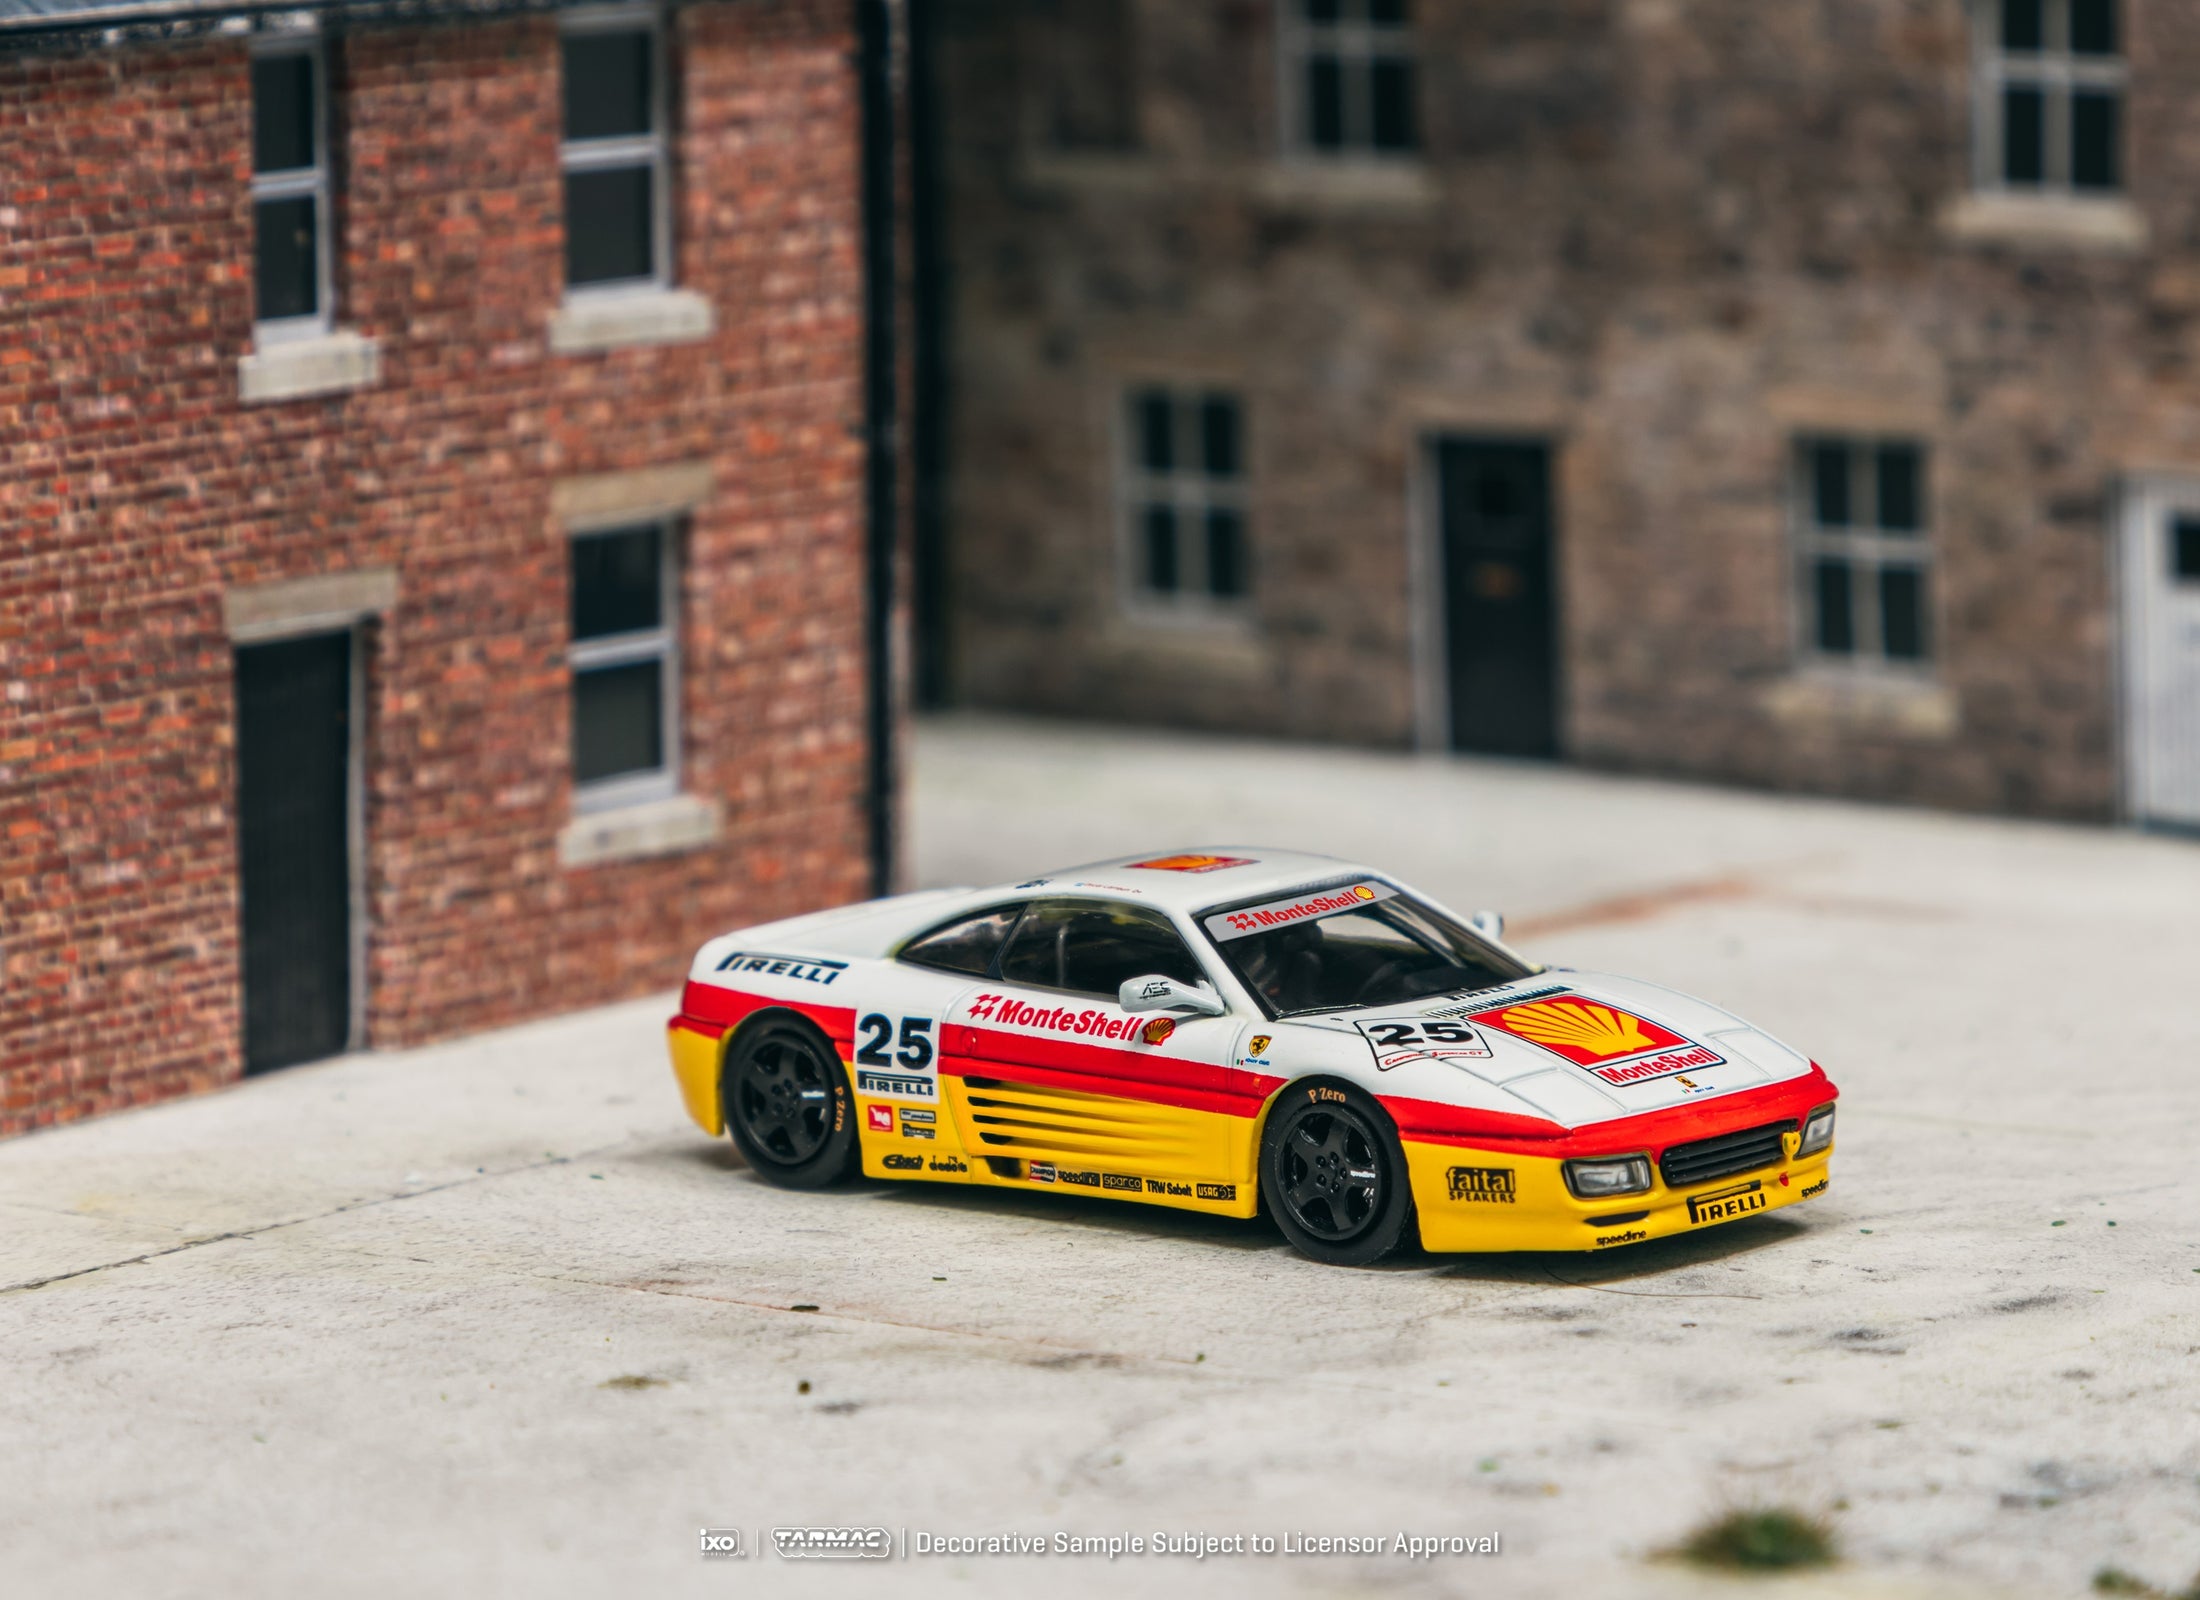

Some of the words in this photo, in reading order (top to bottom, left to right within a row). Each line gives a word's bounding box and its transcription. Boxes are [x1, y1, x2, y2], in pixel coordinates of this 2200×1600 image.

[1253, 891, 1361, 926] MonteShell
[715, 951, 849, 985] PIRELLI
[995, 1000, 1145, 1042] MonteShell
[857, 1012, 933, 1070] 25
[1368, 1022, 1474, 1047] 25
[1597, 1047, 1720, 1084] MonteShell
[857, 1070, 934, 1096] PIRELLI
[1307, 1089, 1317, 1104] P
[1319, 1087, 1346, 1103] Zero
[835, 1101, 846, 1132] Zero
[1103, 1175, 1141, 1190] sparco
[1197, 1186, 1219, 1198] USAG
[1448, 1168, 1515, 1192] faital
[1449, 1191, 1516, 1204] SPEAKERS
[1687, 1180, 1767, 1225] PIRELLI
[1596, 1230, 1647, 1246] speedline
